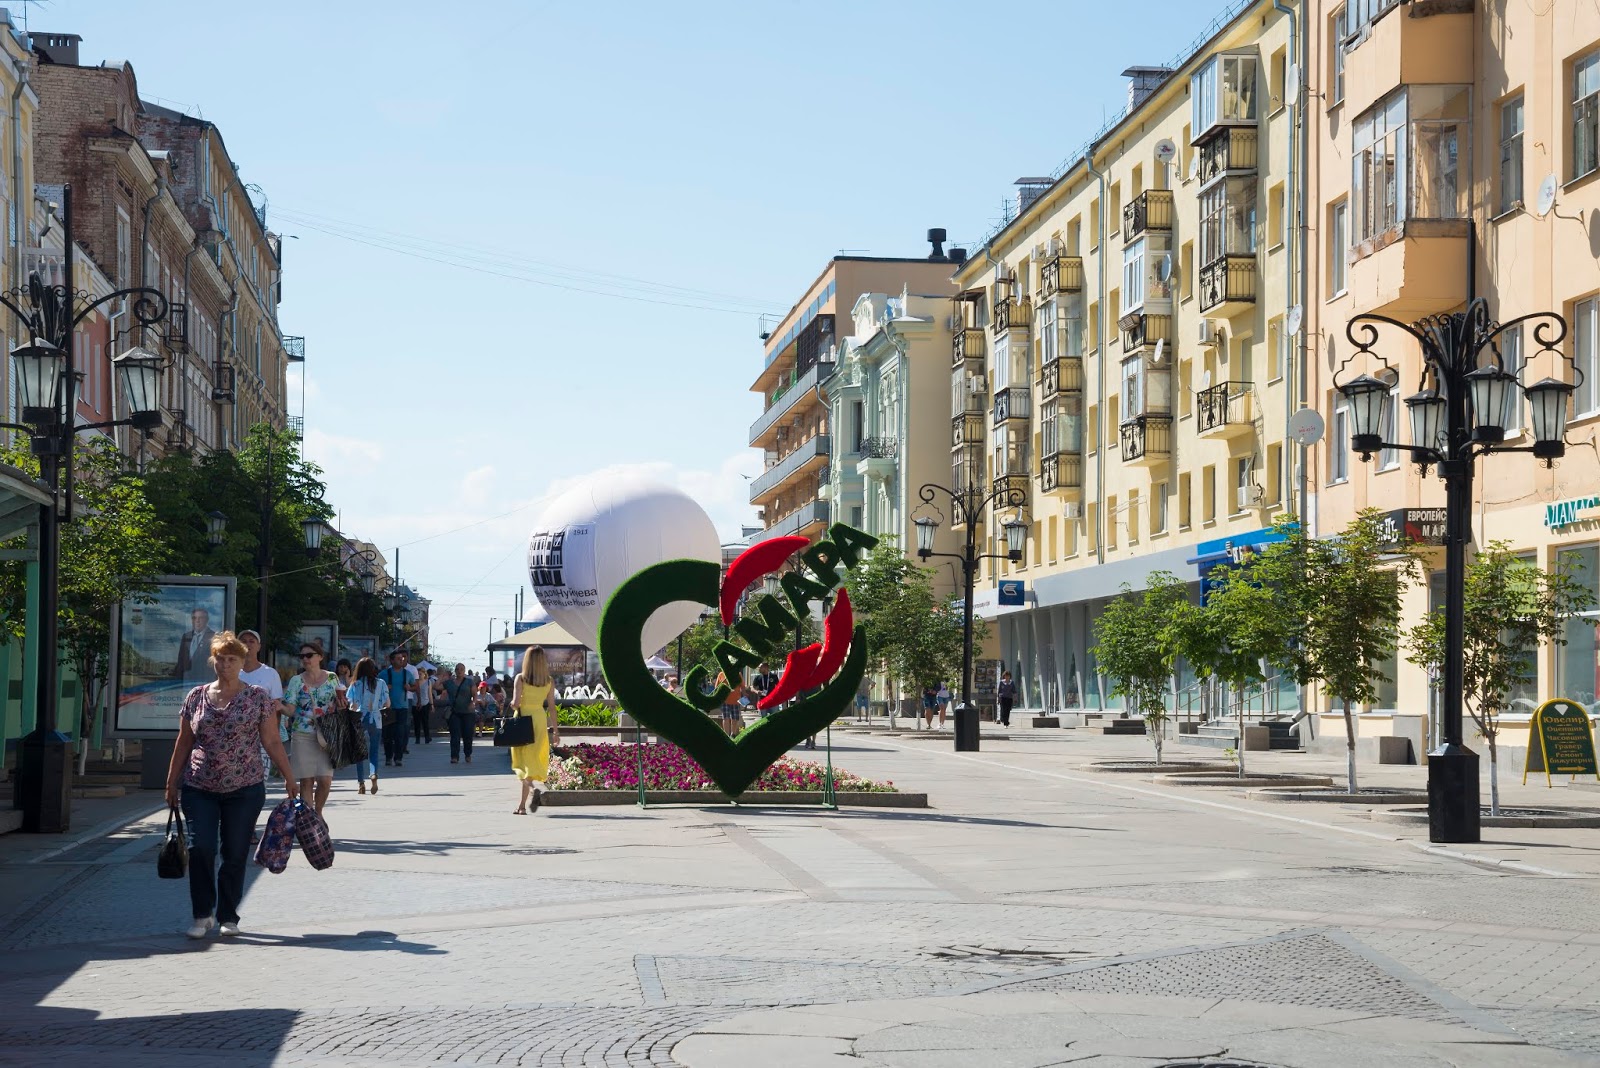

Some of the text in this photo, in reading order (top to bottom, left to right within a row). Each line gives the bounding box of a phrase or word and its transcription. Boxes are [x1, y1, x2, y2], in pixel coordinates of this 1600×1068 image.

[1407, 509, 1447, 522] ЕВРОПЕЙС
[1422, 525, 1447, 536] МАР
[683, 522, 880, 711] САМАРА
[1543, 716, 1585, 724] Ювелир
